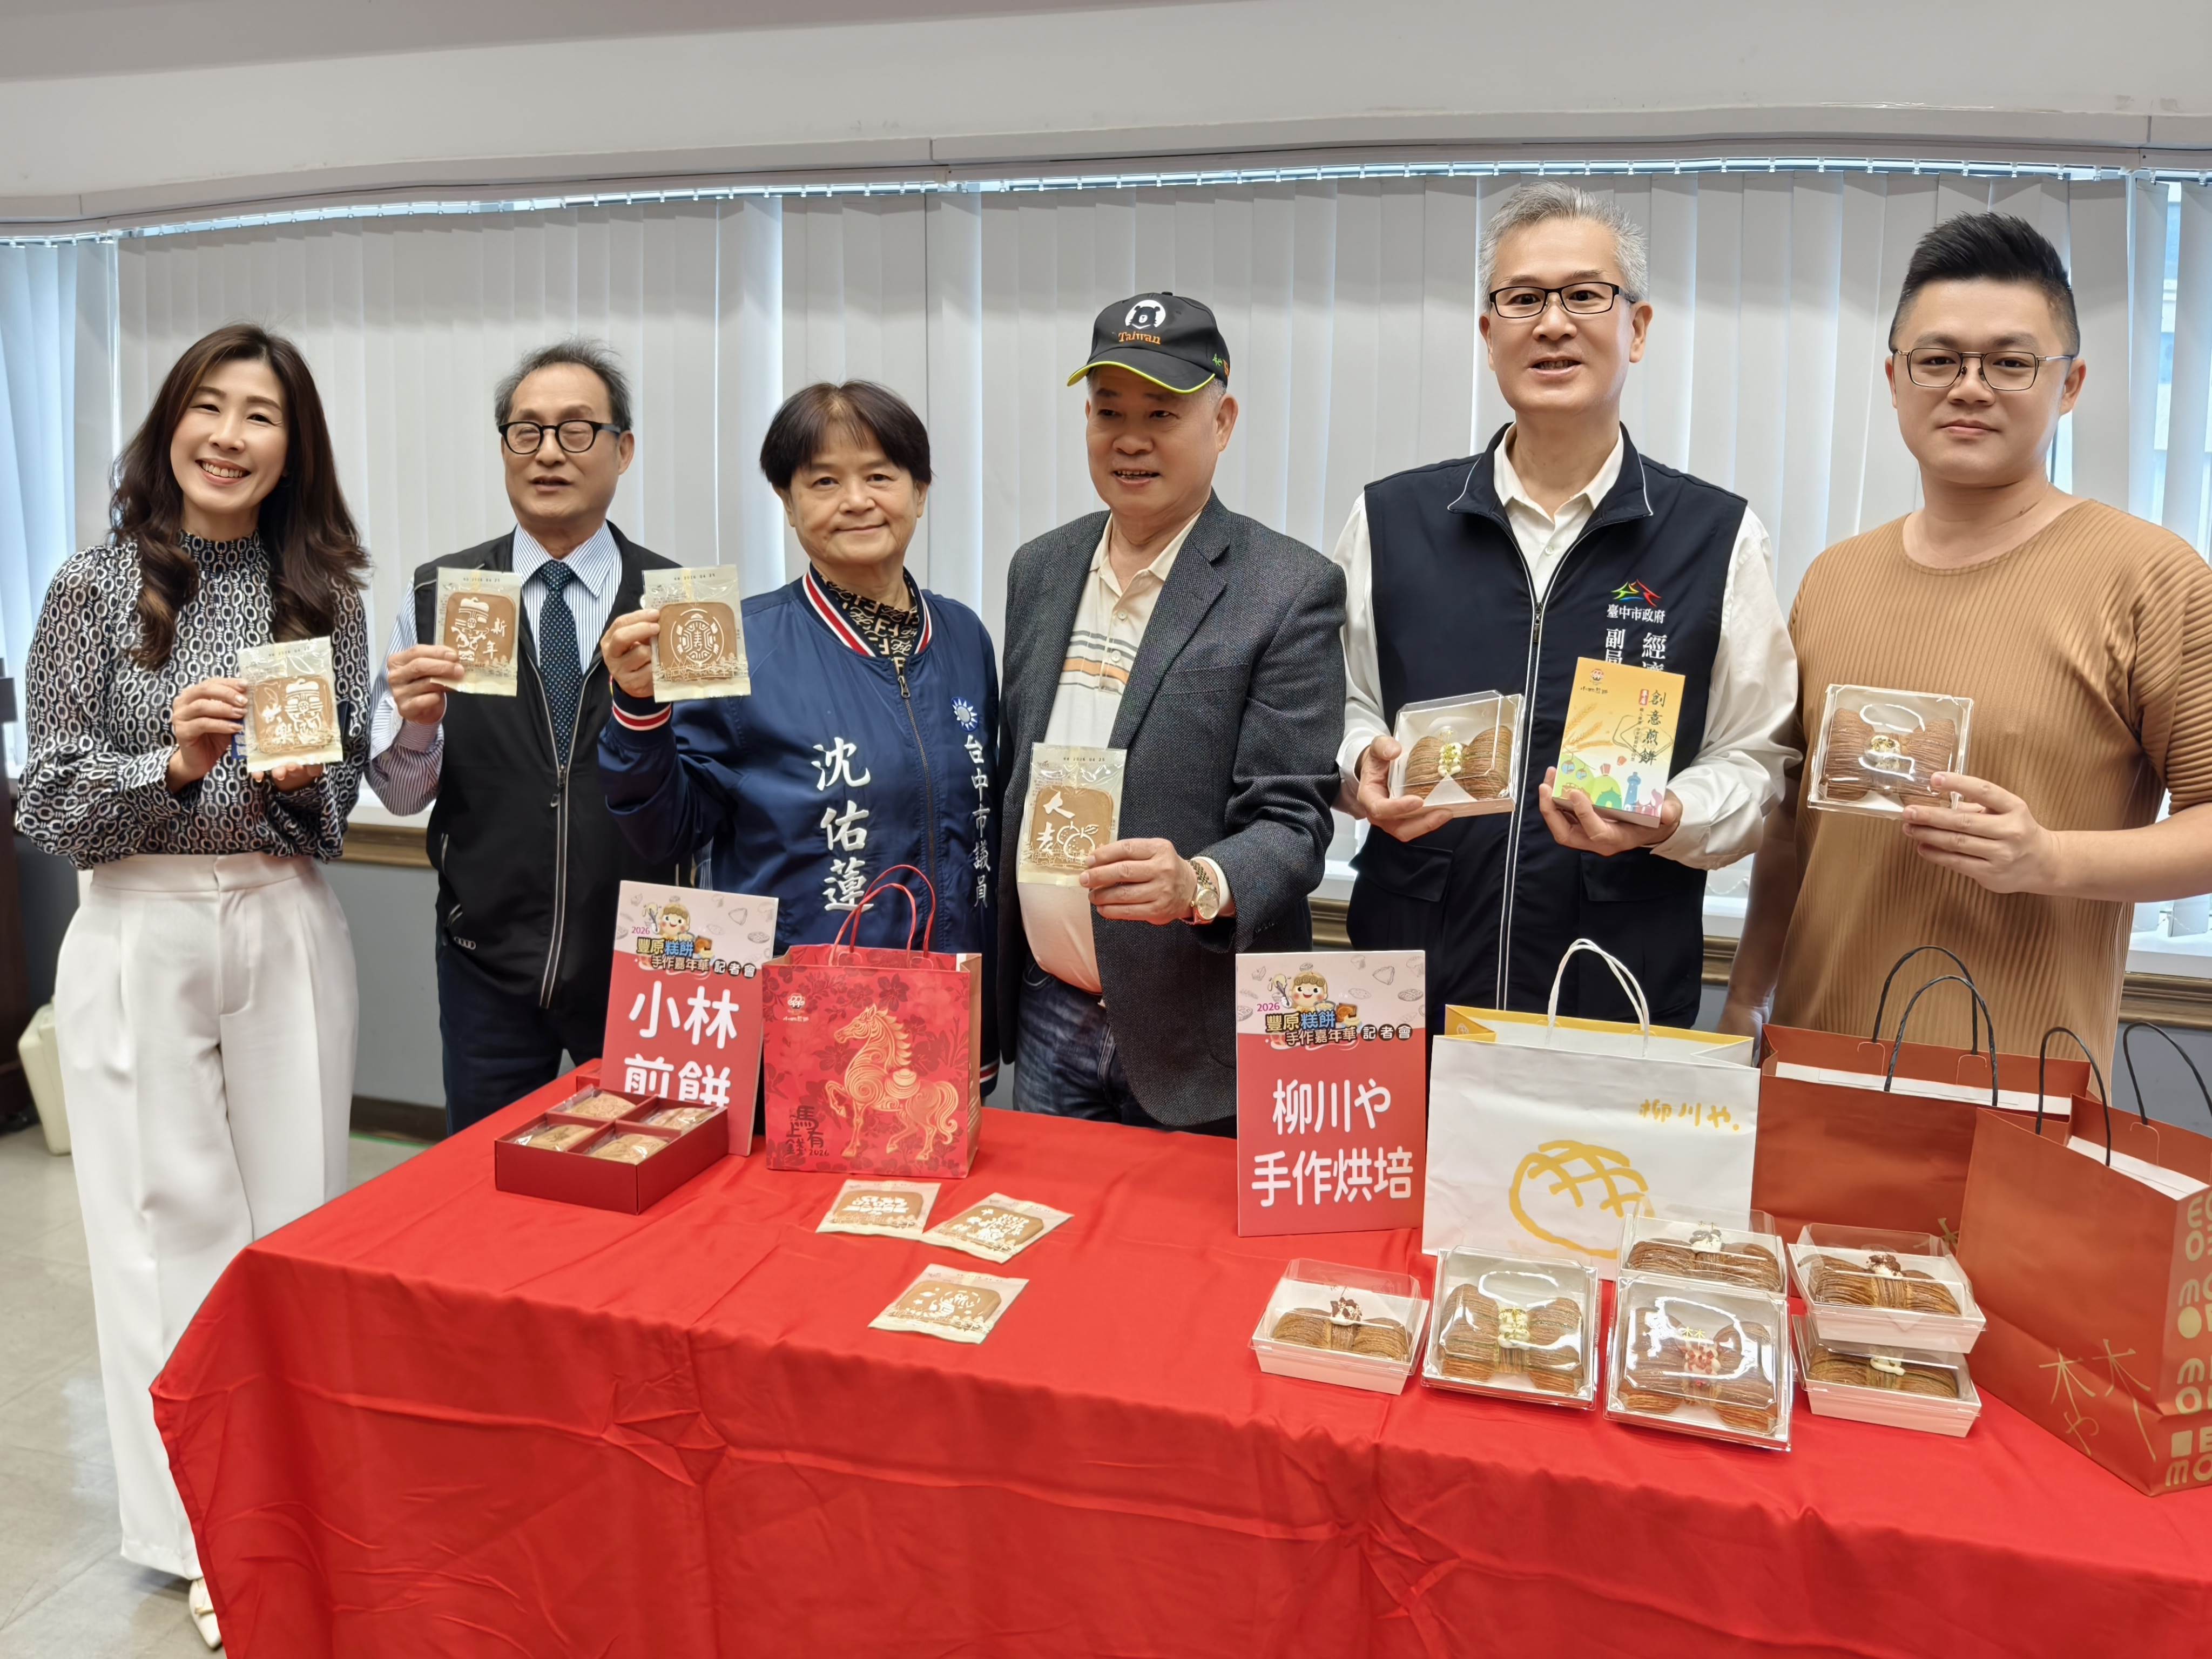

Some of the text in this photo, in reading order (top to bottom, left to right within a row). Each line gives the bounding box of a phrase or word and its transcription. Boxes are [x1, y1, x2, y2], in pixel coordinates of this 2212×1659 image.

[1118, 331, 1161, 345] Taiwan
[1607, 603, 1665, 624] 臺中市政府
[482, 617, 508, 659] 新年
[1638, 689, 1667, 766] 創意煎餅
[811, 737, 874, 911] 沈佑蓮
[964, 734, 990, 909] 台中市議員
[631, 926, 651, 935] 2026
[636, 936, 695, 957] 豐原糕餅
[651, 955, 757, 978] 手作嘉年華 記者會
[629, 980, 740, 1049] 小林
[1257, 1002, 1280, 1012] 2026
[1266, 1011, 1337, 1033] 豐原糕餅
[1285, 1024, 1412, 1046] 手作嘉年華 記者會
[1272, 1078, 1391, 1135] 柳川や
[1251, 1145, 1413, 1207] 手作烘培
